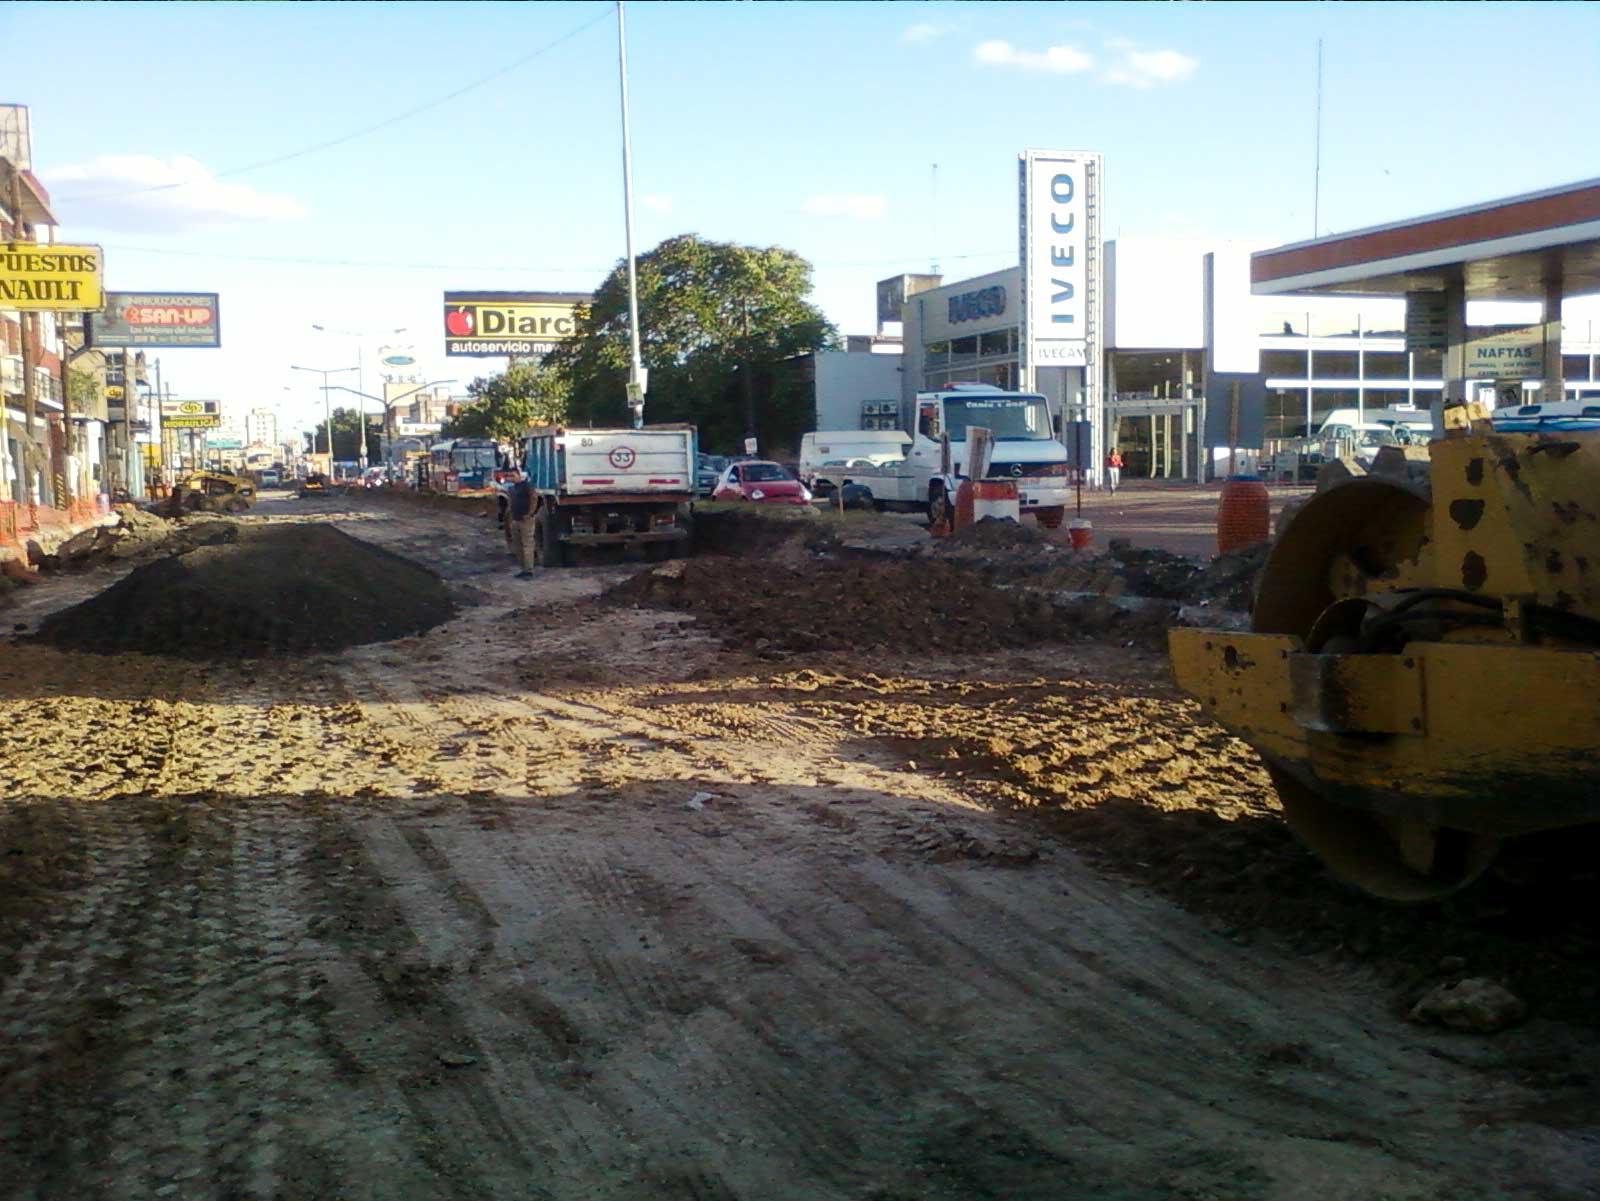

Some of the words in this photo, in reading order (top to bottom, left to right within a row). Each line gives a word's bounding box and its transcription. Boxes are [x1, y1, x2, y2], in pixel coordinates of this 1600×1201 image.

[1050, 173, 1074, 324] IVECO
[482, 309, 574, 335] Diarc
[451, 341, 530, 353] autoservicio
[1477, 347, 1533, 358] NAFTAS
[581, 437, 593, 447] 80
[615, 452, 630, 462] 33
